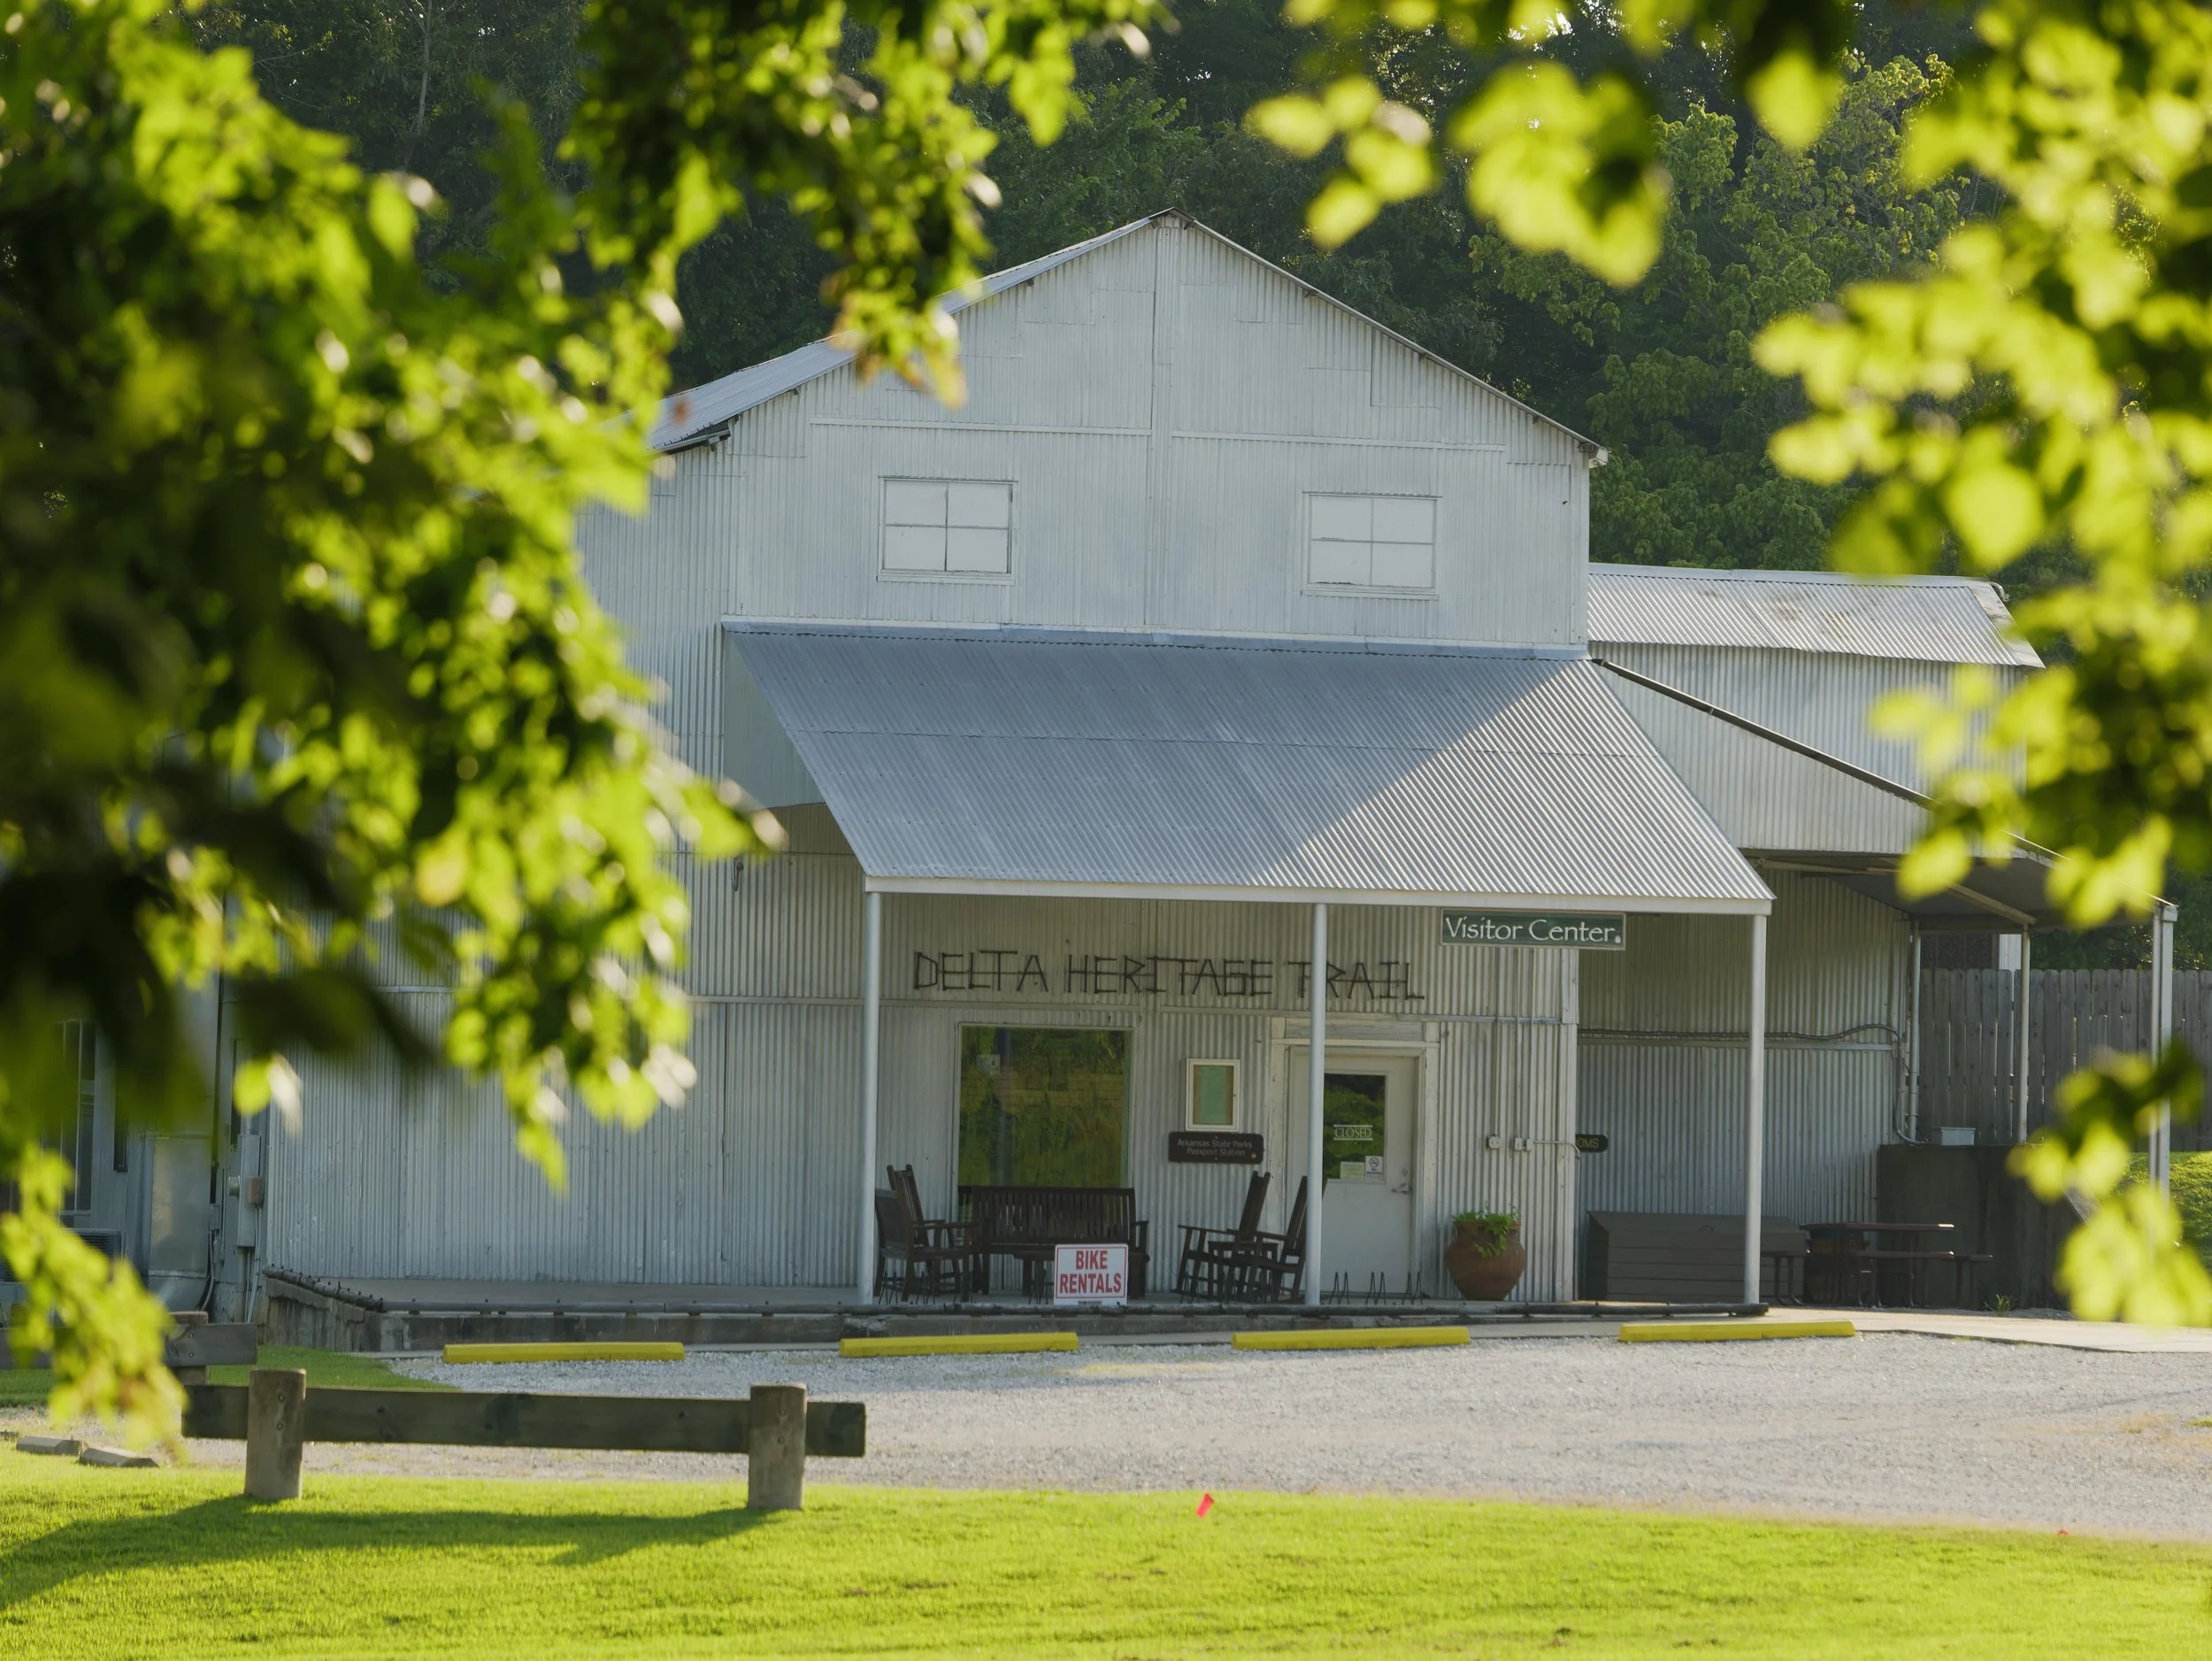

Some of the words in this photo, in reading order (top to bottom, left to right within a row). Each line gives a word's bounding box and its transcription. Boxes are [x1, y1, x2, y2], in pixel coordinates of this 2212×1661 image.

[1445, 916, 1524, 941] Visitor
[1528, 919, 1616, 942] Center
[914, 950, 1048, 991] DELTA
[1067, 955, 1273, 996] HERITAGE
[1287, 961, 1425, 1000] TRAIL
[1334, 1127, 1372, 1138] CLOSED
[1177, 1138, 1210, 1148] Arkansas
[1211, 1139, 1232, 1149] State
[1233, 1140, 1253, 1149] Parks
[1187, 1147, 1217, 1156] Passport
[1219, 1148, 1246, 1157] Station
[1075, 1250, 1108, 1270] BIKE
[1059, 1273, 1122, 1294] RENTALS
